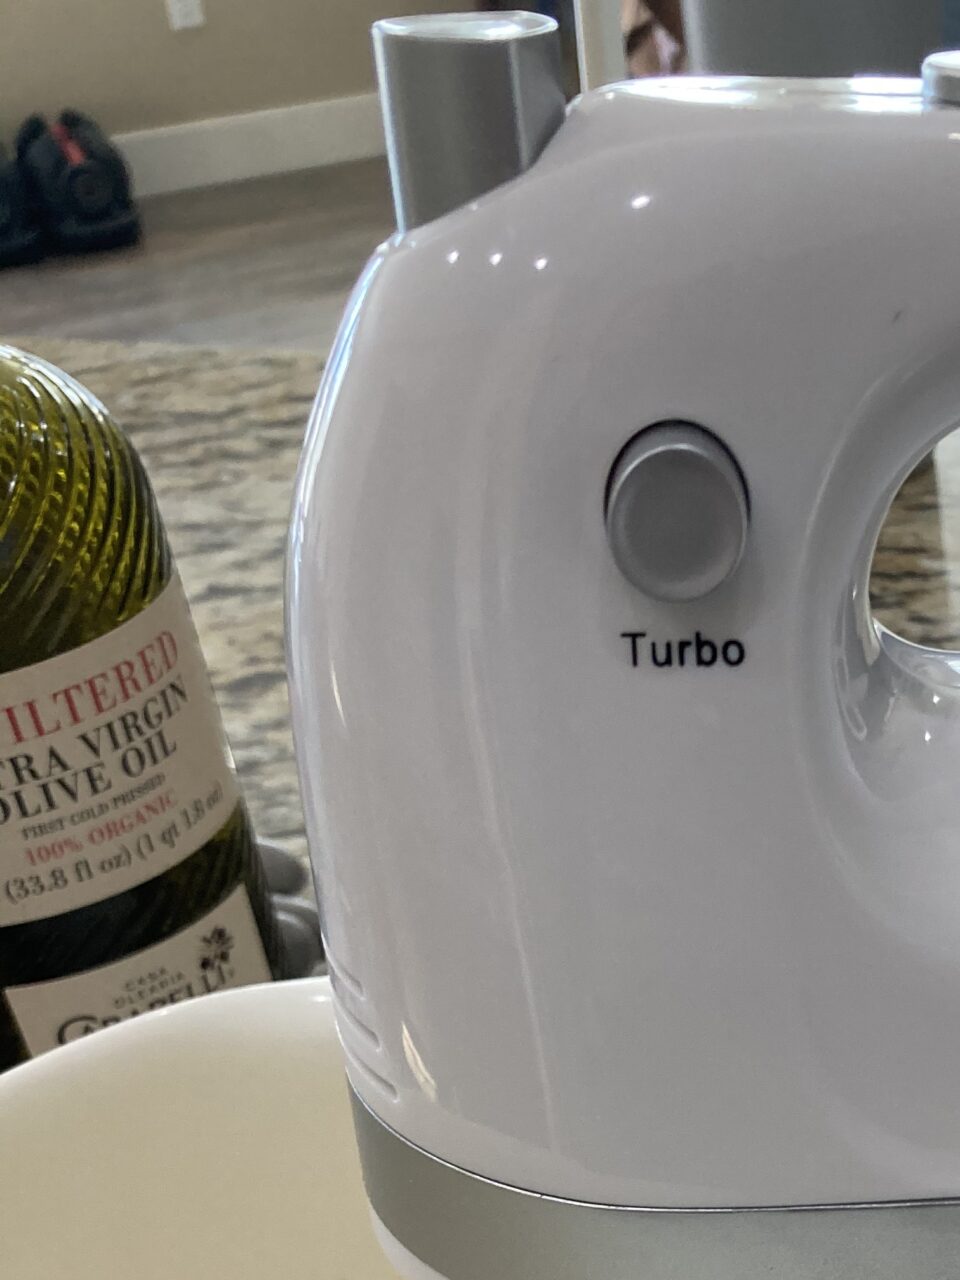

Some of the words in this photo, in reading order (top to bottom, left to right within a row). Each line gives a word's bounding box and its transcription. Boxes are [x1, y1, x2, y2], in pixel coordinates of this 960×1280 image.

[620, 632, 746, 667] Turbo
[77, 674, 190, 756] VIRGIN
[121, 730, 177, 778] OIL
[20, 817, 65, 840] FIRST
[69, 801, 109, 825] COLD
[110, 772, 166, 809] PRESSED
[25, 836, 84, 866] 100%
[87, 788, 176, 845] ORGANIC
[4, 867, 68, 905] (33.8
[73, 857, 94, 882] fl
[98, 843, 133, 873] oz)
[160, 820, 180, 848] qt
